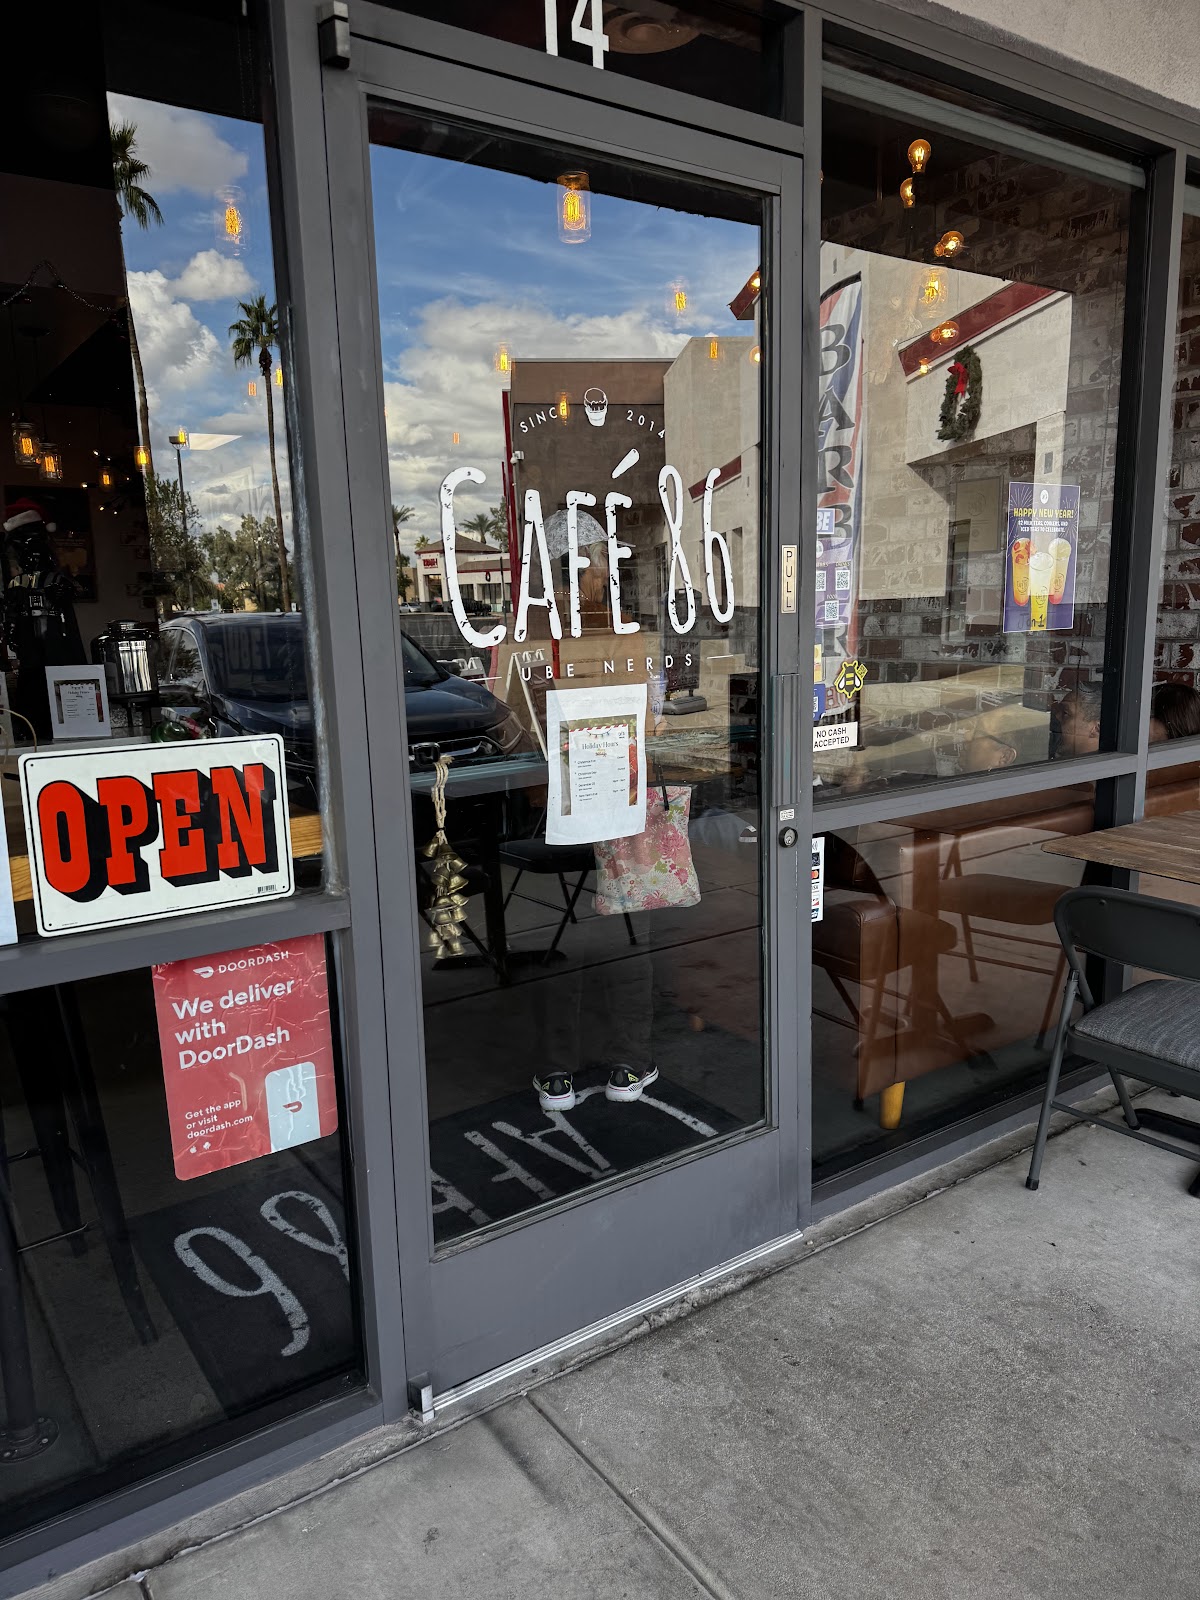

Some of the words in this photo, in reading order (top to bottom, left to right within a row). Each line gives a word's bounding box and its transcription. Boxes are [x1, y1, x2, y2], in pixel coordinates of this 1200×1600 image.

[544, 0, 609, 69] 14
[626, 409, 667, 440] 2014
[1013, 507, 1037, 518] HAPPY
[1039, 508, 1054, 518] NEW
[1055, 509, 1074, 519] YEAR!
[658, 464, 735, 635] 86
[785, 550, 793, 608] PULL
[521, 664, 575, 682] UBE
[604, 653, 693, 674] NERDS
[813, 735, 850, 749] ACCEPTED
[816, 730, 827, 738] NO
[827, 726, 847, 737] CASH
[37, 763, 279, 903] OPEN
[218, 951, 289, 974] DOORDASH
[172, 998, 214, 1020] We
[219, 980, 295, 1010] deliver
[175, 1018, 227, 1045] with
[178, 1026, 291, 1070] DoorDash
[185, 1109, 204, 1120] Get
[205, 1105, 222, 1115] the
[223, 1099, 242, 1110] app
[186, 1121, 197, 1130] or
[198, 1114, 218, 1126] visit
[187, 1115, 253, 1140] doordash.com
